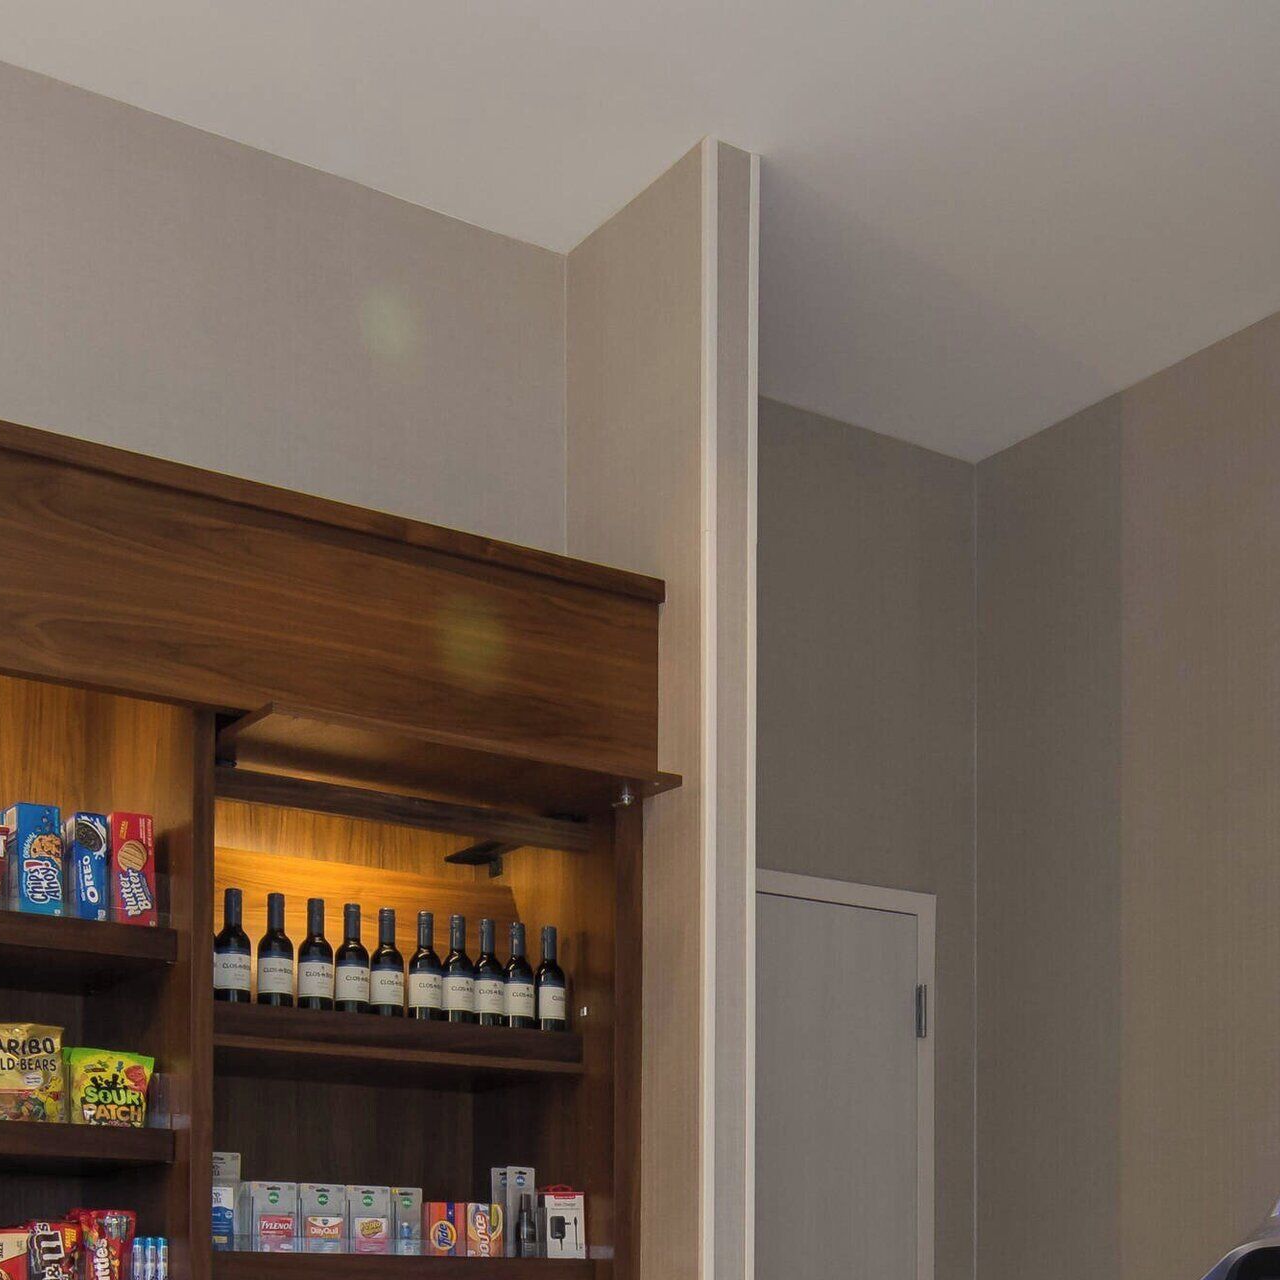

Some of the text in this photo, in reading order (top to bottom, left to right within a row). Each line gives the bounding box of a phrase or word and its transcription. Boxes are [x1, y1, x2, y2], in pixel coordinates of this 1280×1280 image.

[83, 855, 99, 903] OREO
[85, 1085, 141, 1105] SOUR
[83, 1104, 143, 1122] PATCH
[260, 1220, 293, 1231] TYLENOL
[437, 1223, 451, 1248] Tide
[474, 1213, 491, 1257] ounce
